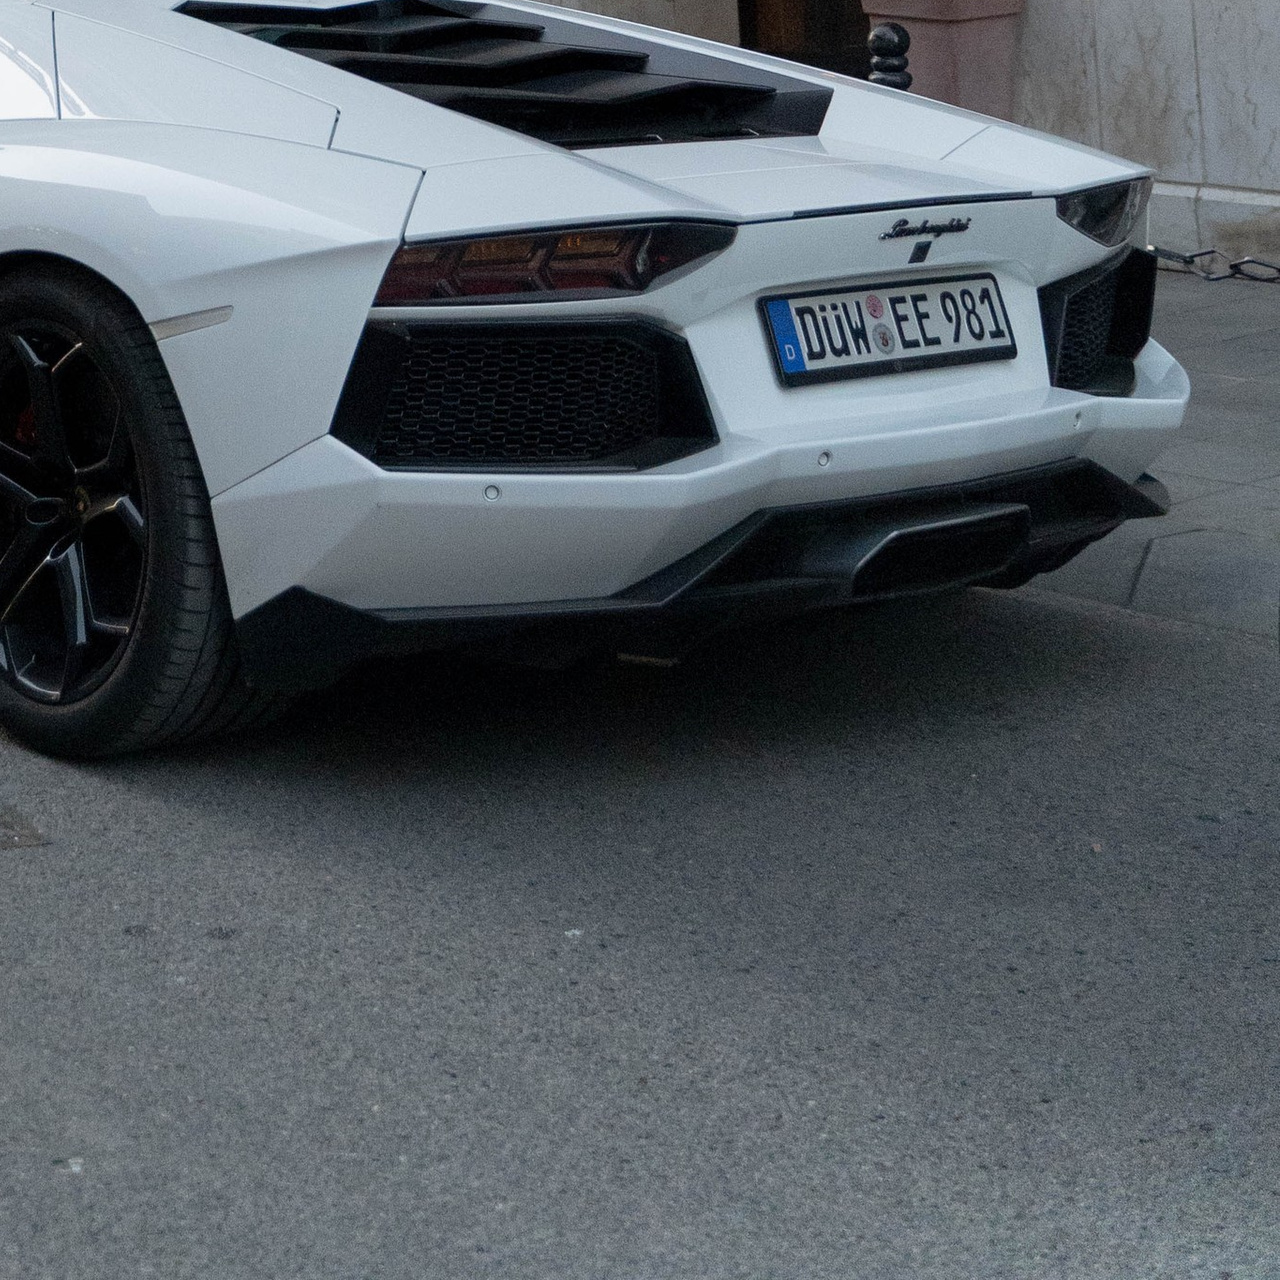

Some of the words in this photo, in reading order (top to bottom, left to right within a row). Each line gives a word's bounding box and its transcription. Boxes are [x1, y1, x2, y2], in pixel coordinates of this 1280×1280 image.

[878, 218, 972, 240] Lamborghini
[888, 293, 942, 349] EE
[939, 287, 1006, 343] 981
[784, 344, 796, 361] D
